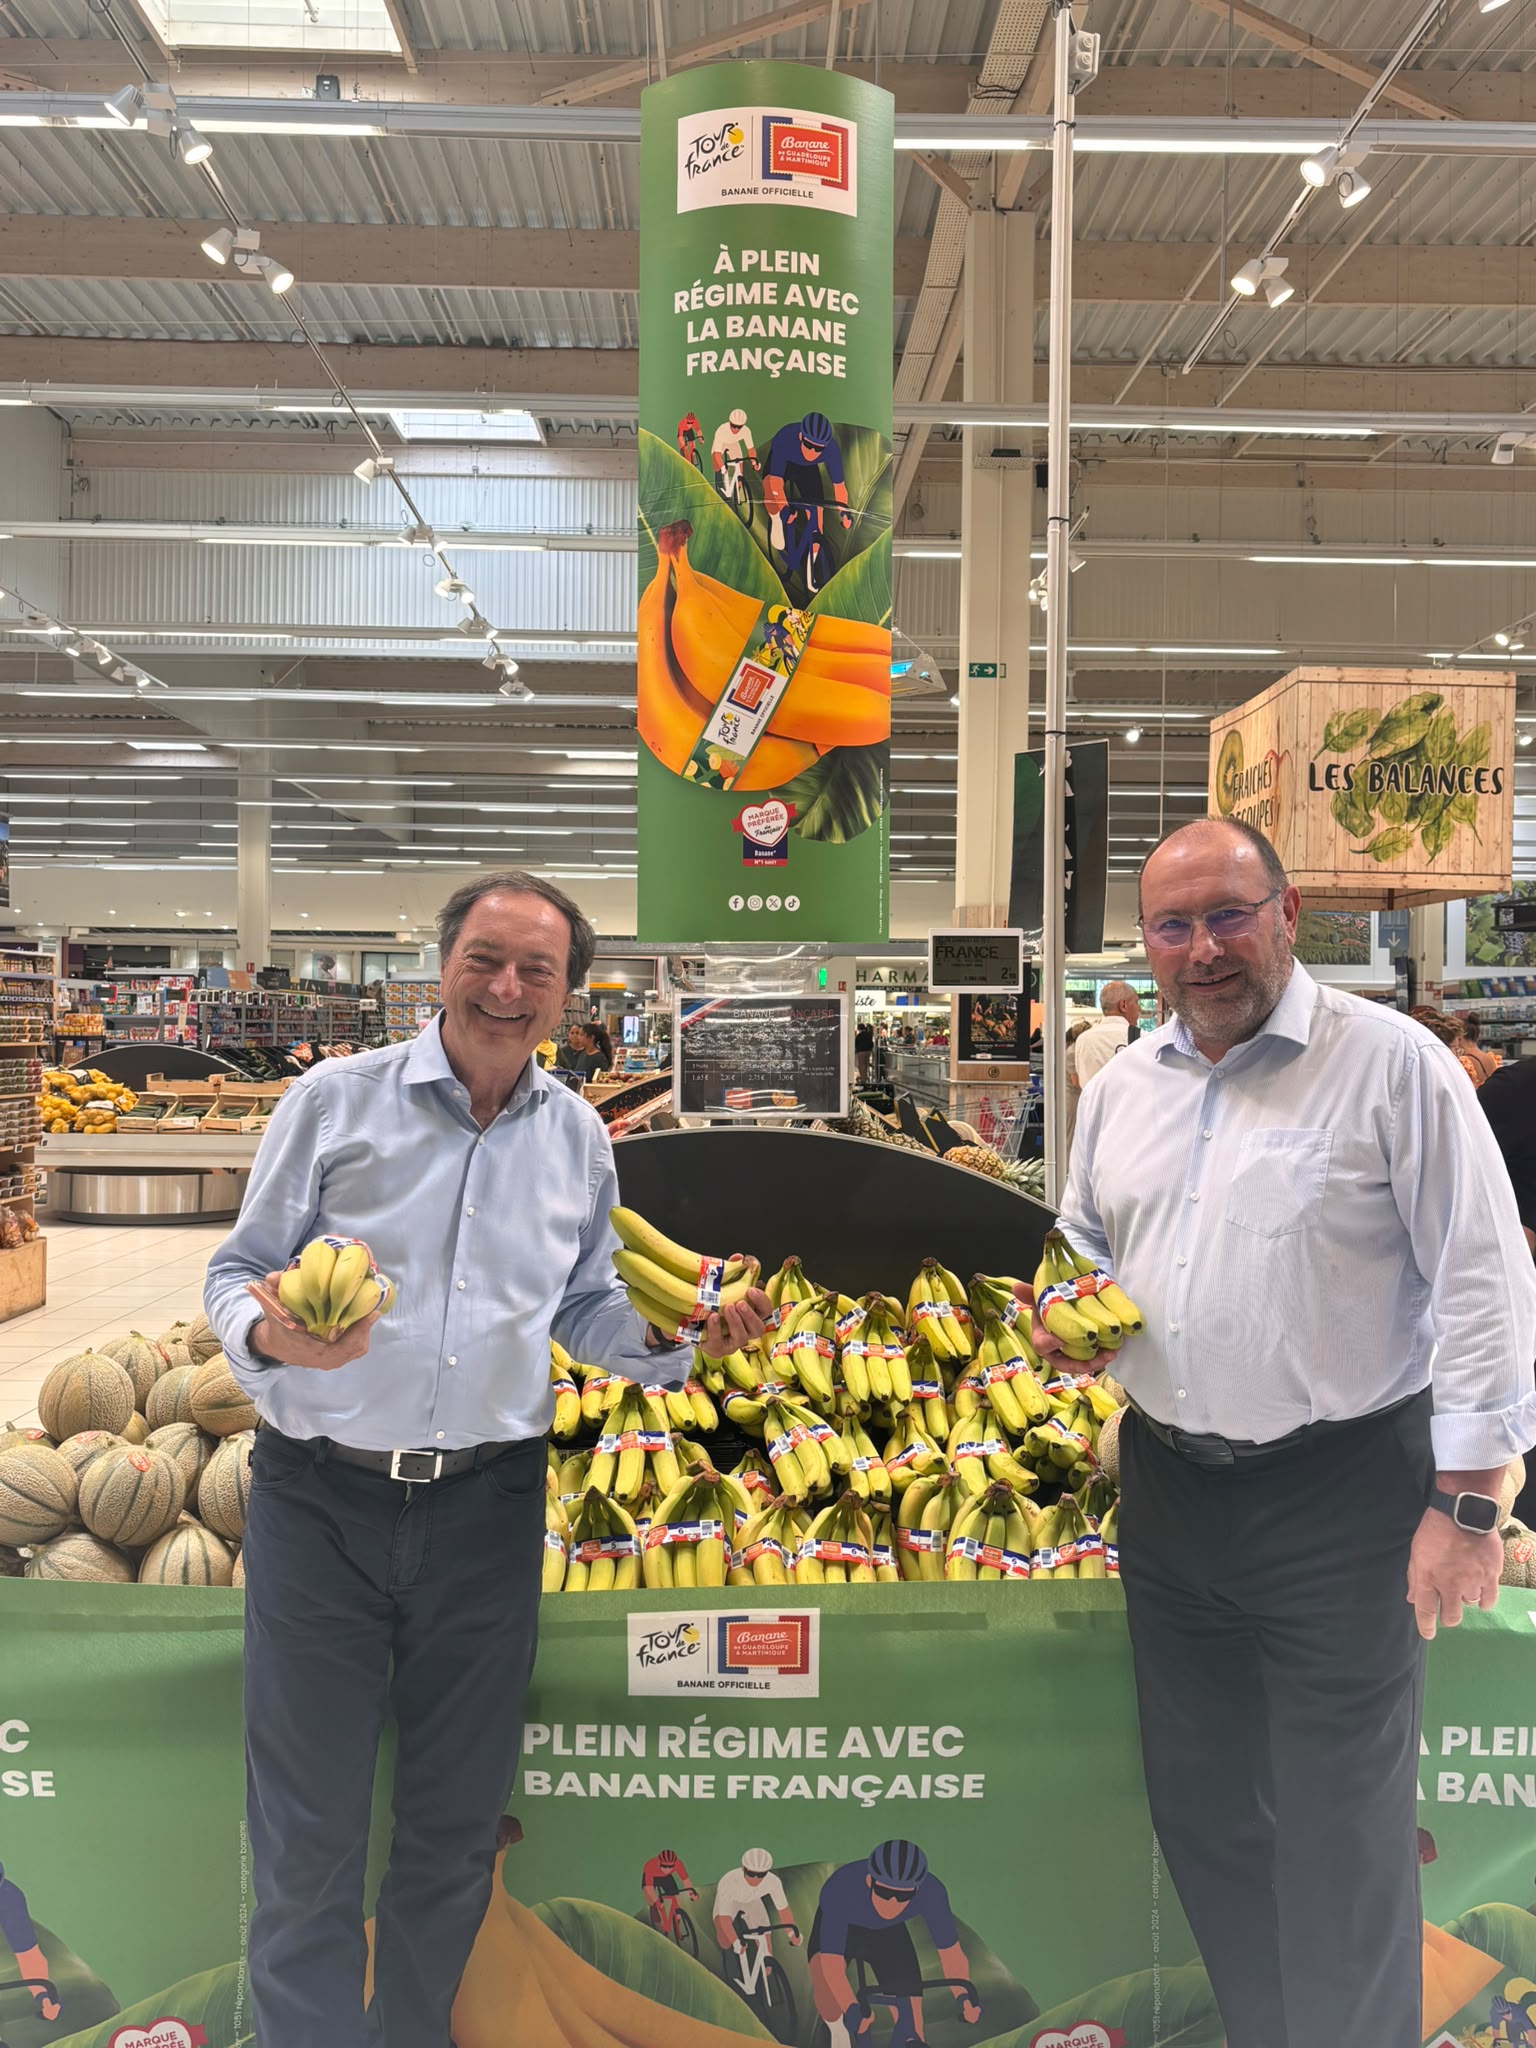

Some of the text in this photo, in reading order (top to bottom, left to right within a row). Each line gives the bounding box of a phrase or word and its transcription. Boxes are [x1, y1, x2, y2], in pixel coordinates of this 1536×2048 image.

[781, 136, 831, 152] Banane
[786, 151, 831, 162] GUADELOUPE
[786, 155, 829, 168] MARTINIQUE
[721, 187, 814, 199] BANANE OFFICIELLE
[713, 243, 819, 276] À PLEIN
[674, 279, 860, 315] RÉGIME AVEC
[687, 315, 847, 346] LA BANANE
[686, 348, 847, 379] FRANÇAISE
[1309, 761, 1505, 796] LES BALANCES
[748, 807, 780, 821] MARQUE
[1229, 796, 1274, 832] COUPES
[935, 945, 999, 960] FRANCE
[733, 1008, 775, 1019] BANANE
[736, 1631, 788, 1644] Banane
[677, 1680, 771, 1690] BANANE OFFICIELLE
[523, 1714, 965, 1759] PLEIN RÉGIME AVEC
[1441, 1726, 1536, 1756] PLEI
[1, 1769, 56, 1797] SE
[524, 1771, 985, 1808] BANANE FRANÇAISE
[1437, 1771, 1536, 1808] BAN
[240, 1820, 248, 1854] bananes
[240, 1855, 250, 1894] catégorie
[1152, 1857, 1161, 1899] catégorie
[1152, 1909, 1160, 1930] 2024
[1152, 1932, 1160, 1953] août
[236, 1956, 246, 2010] répondants
[1153, 1963, 1163, 2014] répondants
[234, 2011, 242, 2030] 1051
